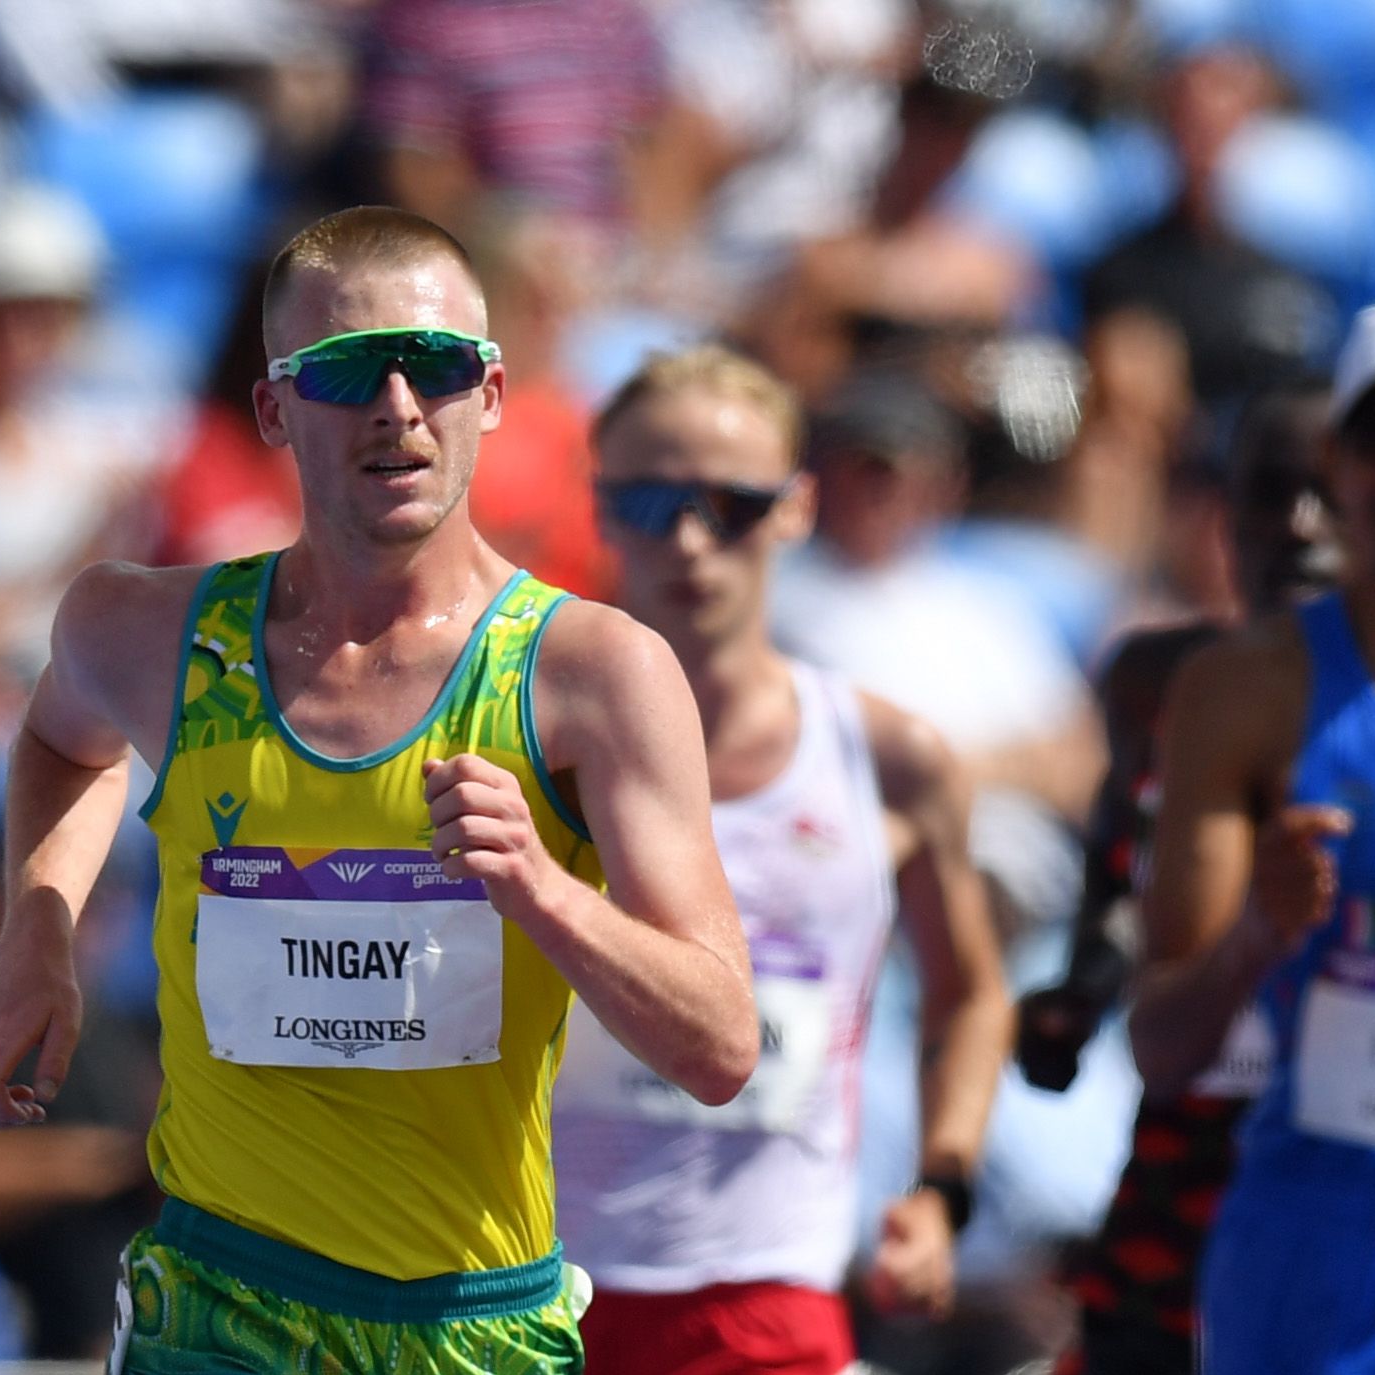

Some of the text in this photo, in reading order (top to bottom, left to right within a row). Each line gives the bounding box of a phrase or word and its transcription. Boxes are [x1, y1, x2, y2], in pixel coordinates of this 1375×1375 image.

[229, 873, 260, 888] 2022
[280, 936, 411, 981] TINGAY
[273, 1015, 426, 1043] LONGINES
